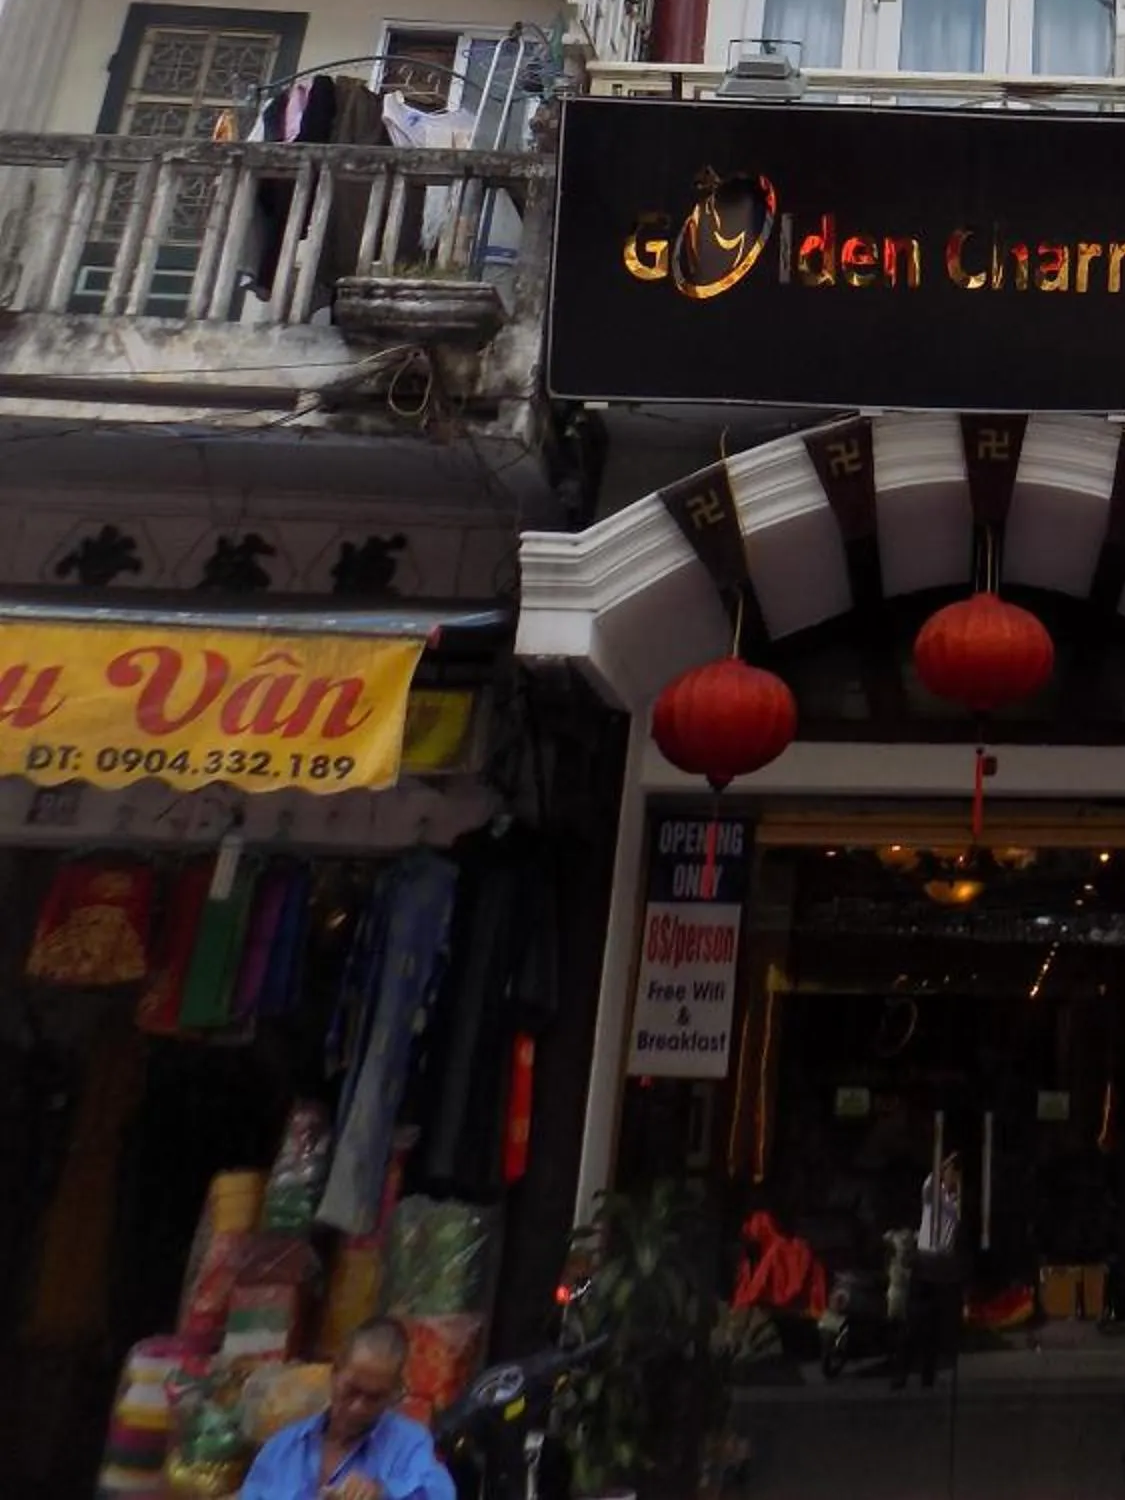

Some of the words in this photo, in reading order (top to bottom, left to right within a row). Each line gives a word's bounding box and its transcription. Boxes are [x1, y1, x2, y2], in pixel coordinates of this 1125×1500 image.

[106, 645, 373, 739] Vân
[96, 746, 356, 780] 0904.332.189
[647, 981, 687, 1001] Free
[675, 1004, 690, 1026] &
[636, 1030, 726, 1052] Breakfast
